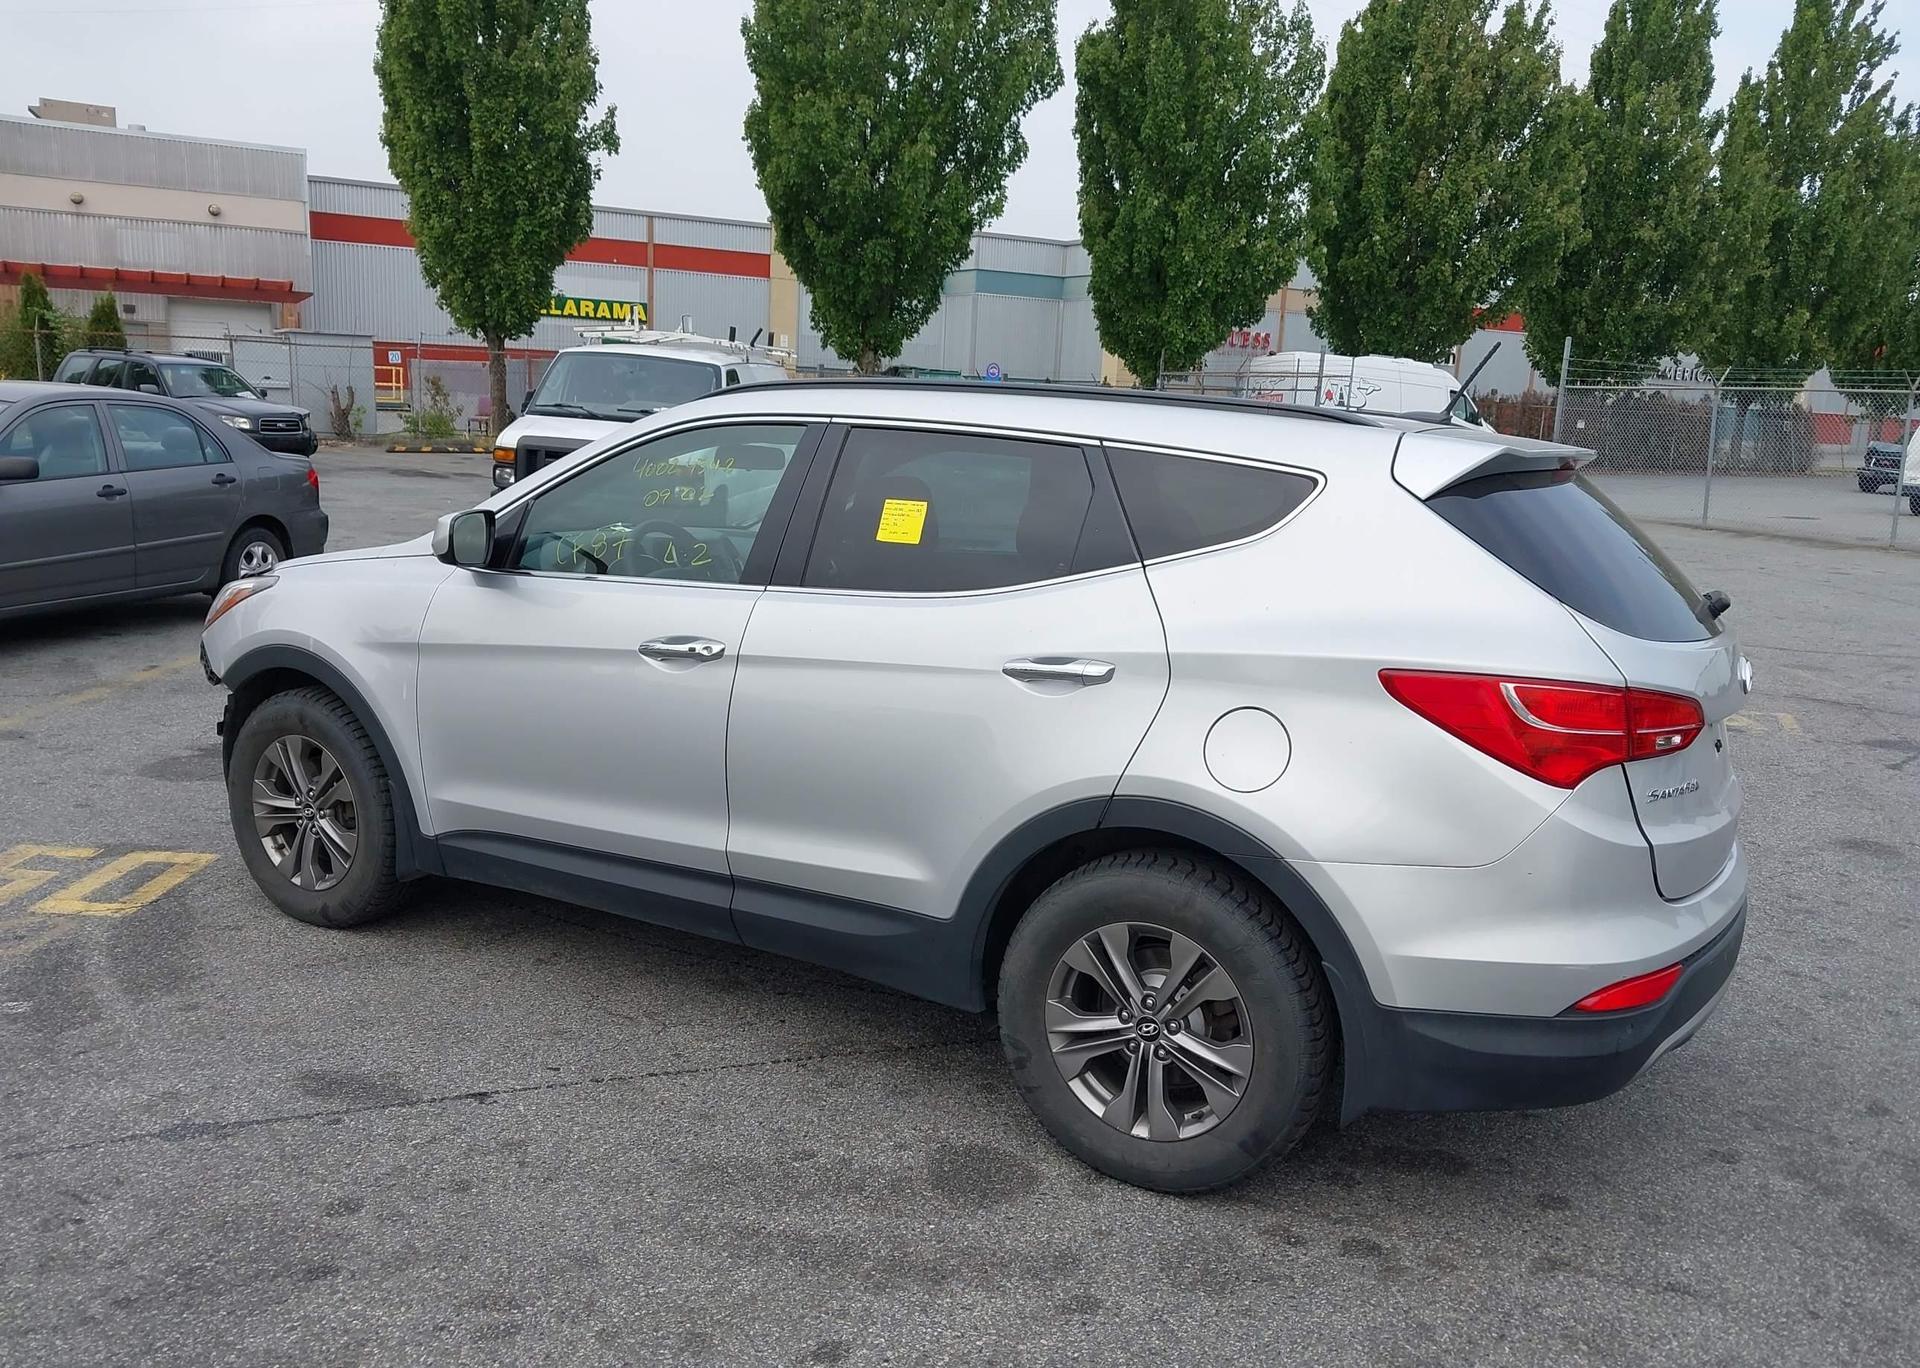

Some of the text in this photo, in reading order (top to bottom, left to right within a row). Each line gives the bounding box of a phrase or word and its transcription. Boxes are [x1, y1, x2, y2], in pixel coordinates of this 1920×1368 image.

[540, 297, 647, 321] LARAMA
[390, 352, 400, 362] 20
[1651, 366, 1714, 382] MERICA
